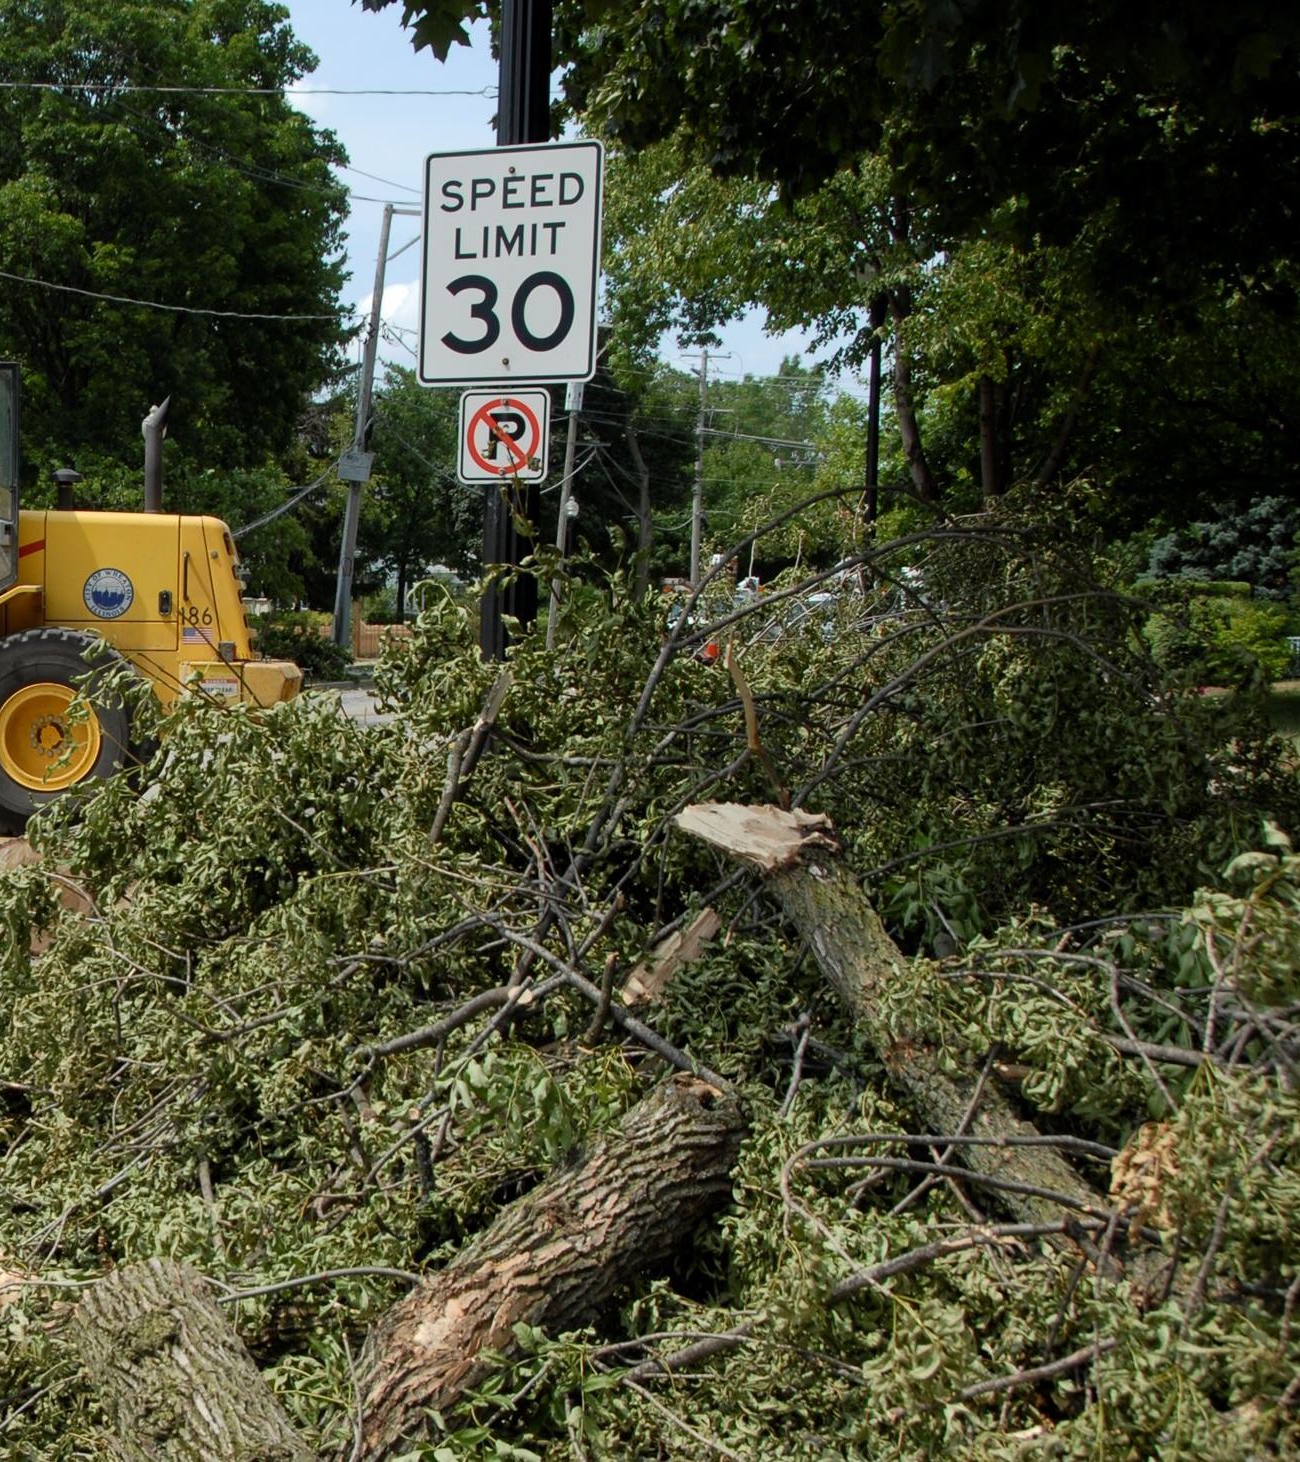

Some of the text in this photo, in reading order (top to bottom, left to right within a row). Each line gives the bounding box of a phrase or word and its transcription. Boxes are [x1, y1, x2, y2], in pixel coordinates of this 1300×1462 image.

[440, 172, 584, 212] SPEED
[455, 221, 566, 259] LIMIT
[441, 270, 575, 354] 30
[488, 412, 526, 460] P
[92, 571, 102, 580] OF
[104, 570, 132, 601] WHEATON
[91, 605, 124, 617] ILLINOIS
[181, 606, 213, 625] 186
